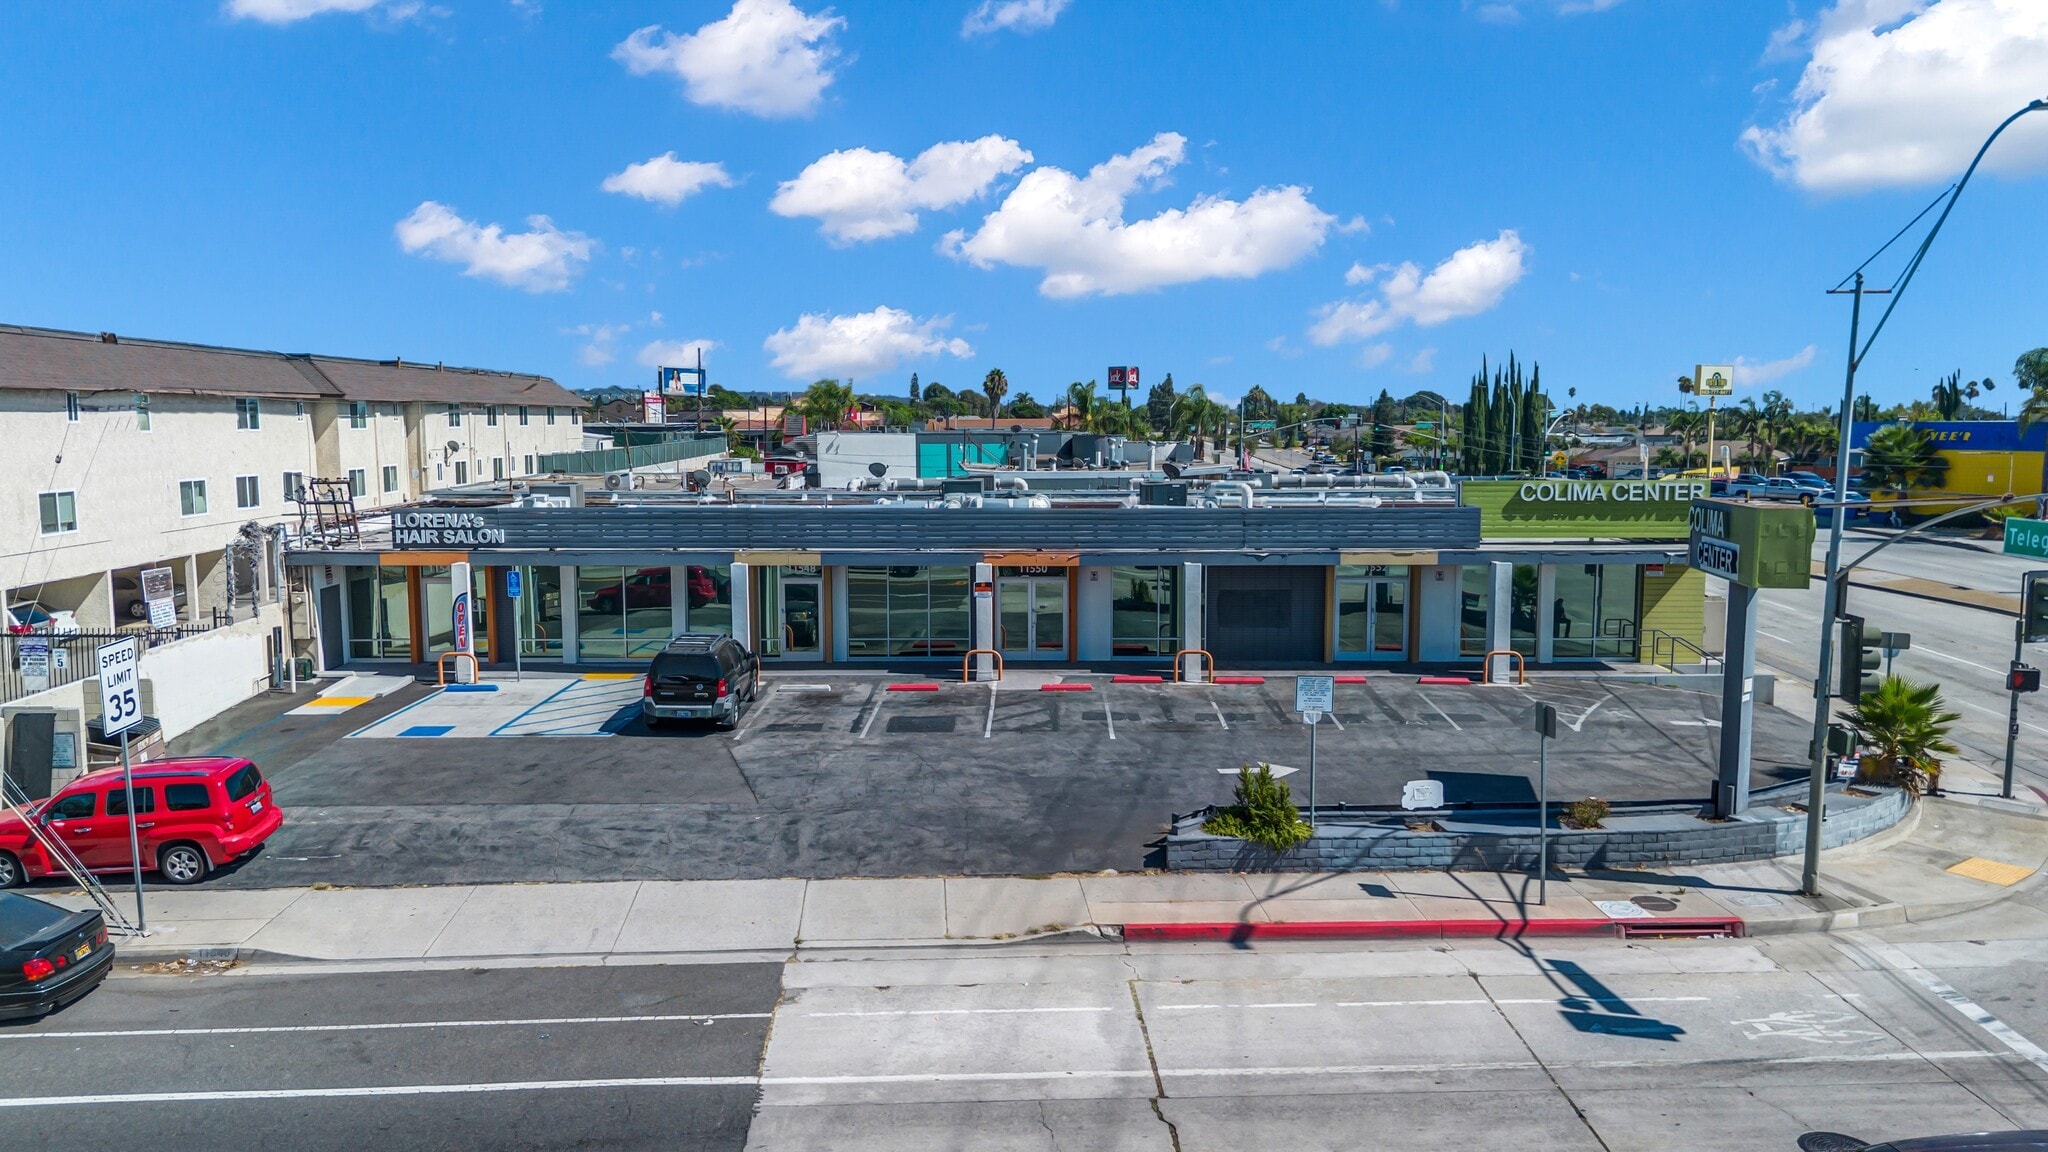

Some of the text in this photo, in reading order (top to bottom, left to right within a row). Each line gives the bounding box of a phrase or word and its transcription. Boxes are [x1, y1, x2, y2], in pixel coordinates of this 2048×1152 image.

[1520, 483, 1705, 501] COLIMA CENTER
[394, 513, 484, 528] LORENA's
[1688, 506, 1724, 538] COLIMA
[395, 528, 505, 544] HAIR SALON
[1697, 542, 1733, 575] CENTER
[456, 602, 466, 648] OPEN
[57, 658, 64, 668] 5
[102, 647, 133, 668] SPEED
[107, 668, 132, 688] LIMIT
[109, 688, 136, 722] 35
